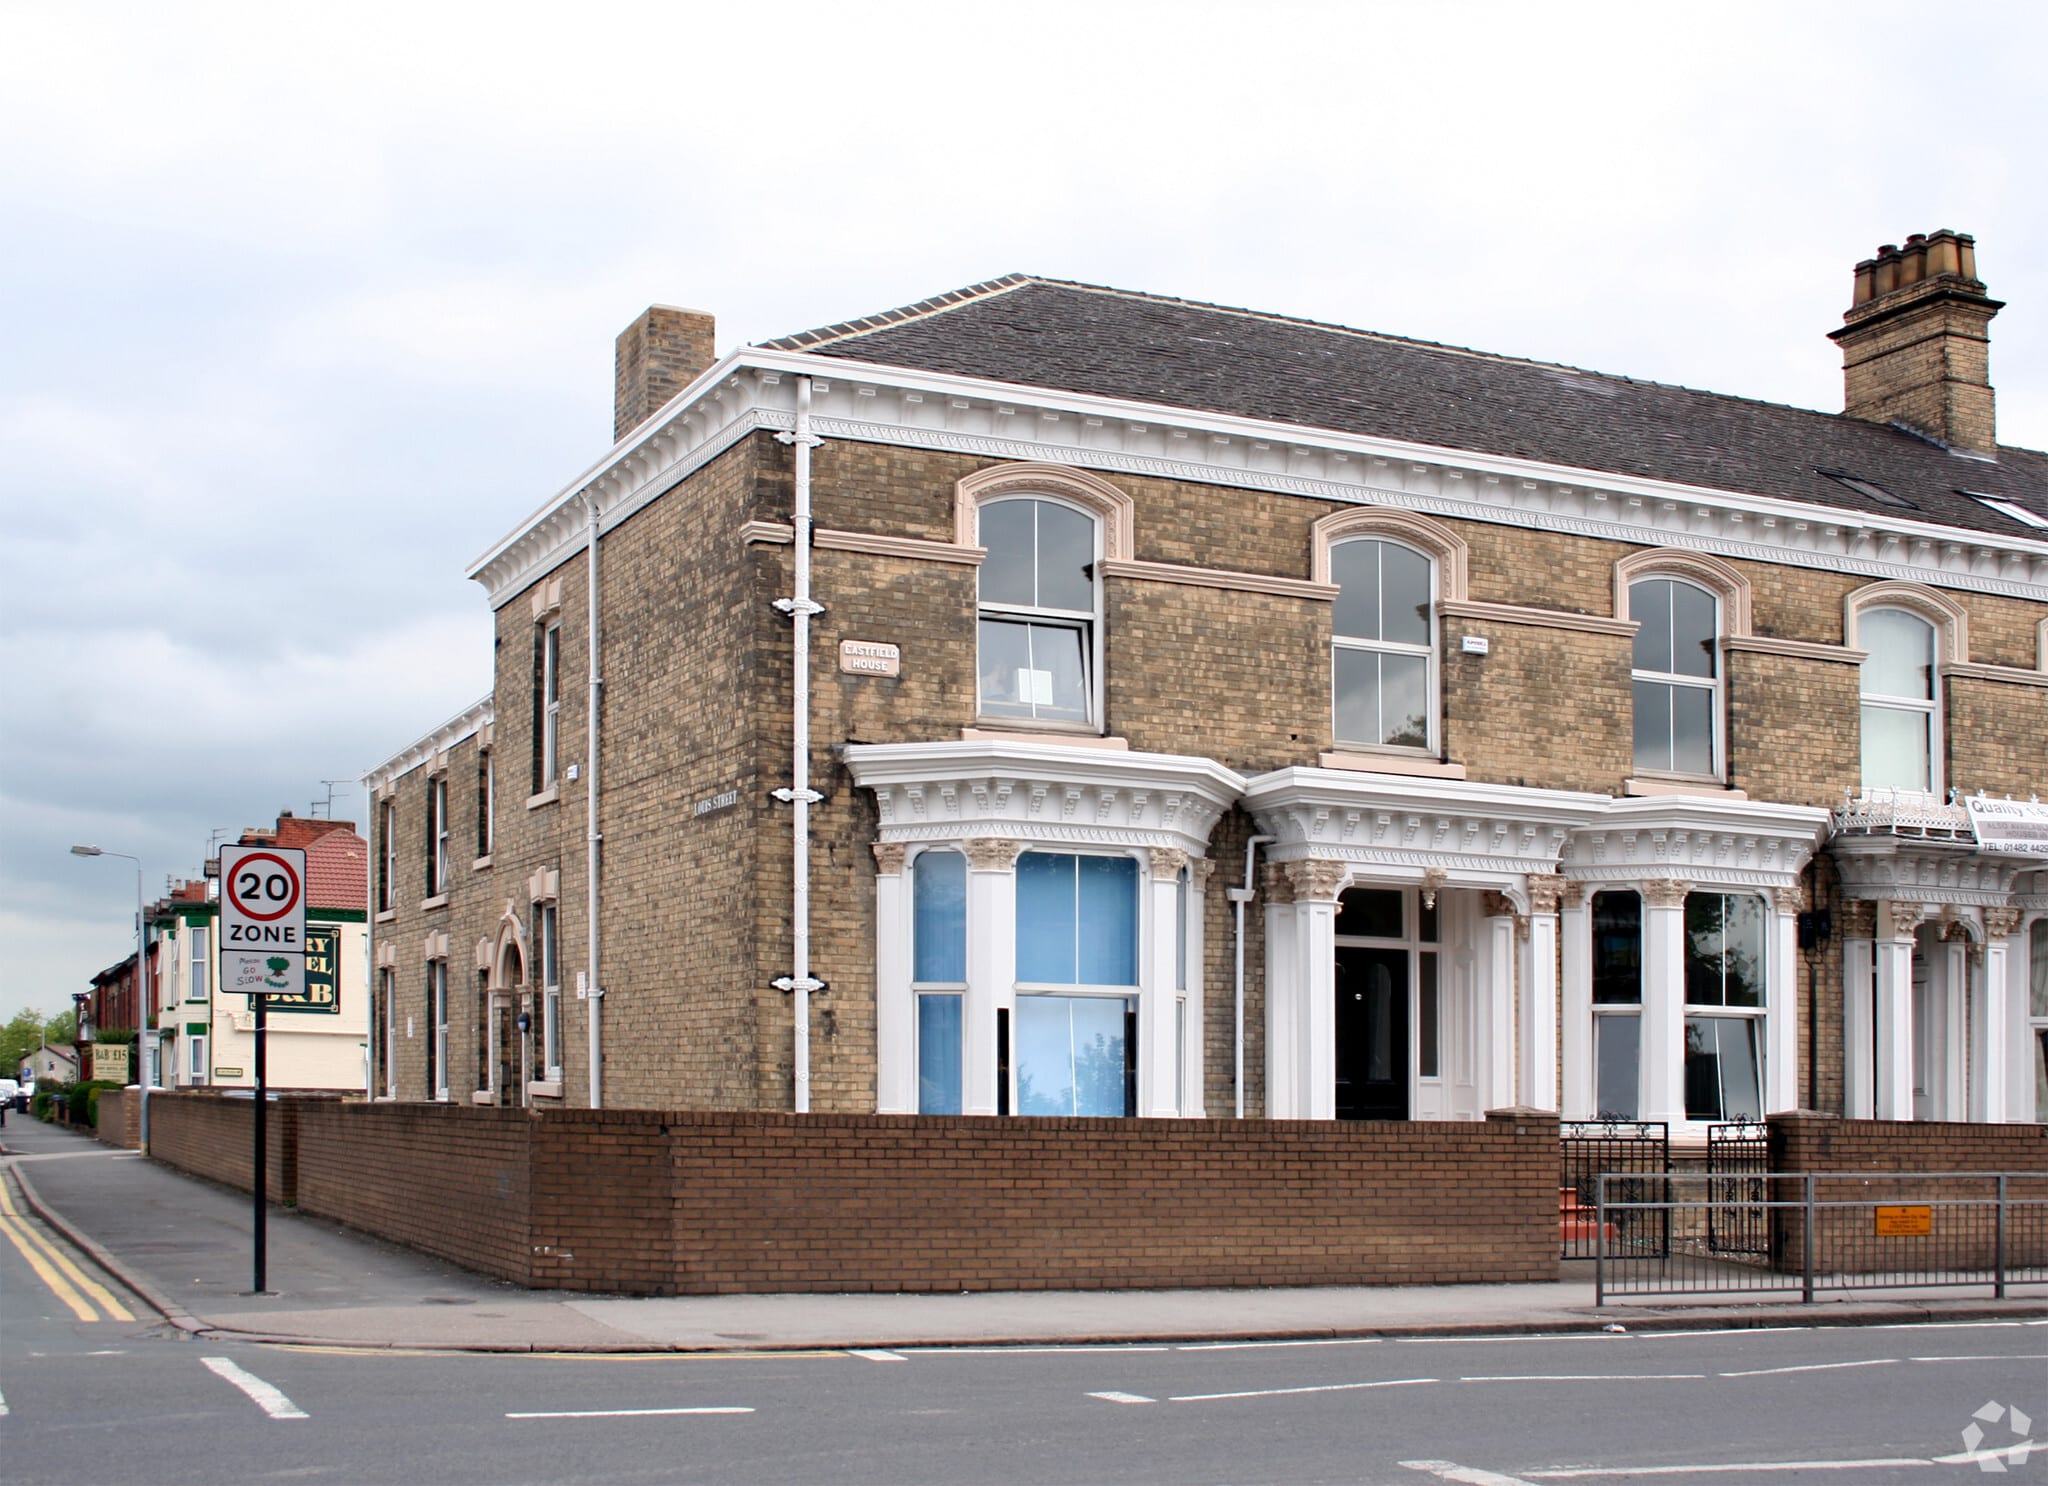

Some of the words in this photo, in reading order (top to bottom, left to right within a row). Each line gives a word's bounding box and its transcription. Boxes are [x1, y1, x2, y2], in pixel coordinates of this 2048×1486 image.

[845, 644, 898, 659] EASTFIELD
[852, 659, 889, 671] HOUSE
[713, 790, 737, 809] STREET
[1971, 800, 2024, 817] Quality
[1983, 842, 2002, 852] TEL:
[2004, 843, 2028, 853] 01482
[239, 873, 289, 901] 20
[230, 925, 296, 943] ZONE
[243, 967, 256, 975] GO
[236, 975, 264, 986] SLOW
